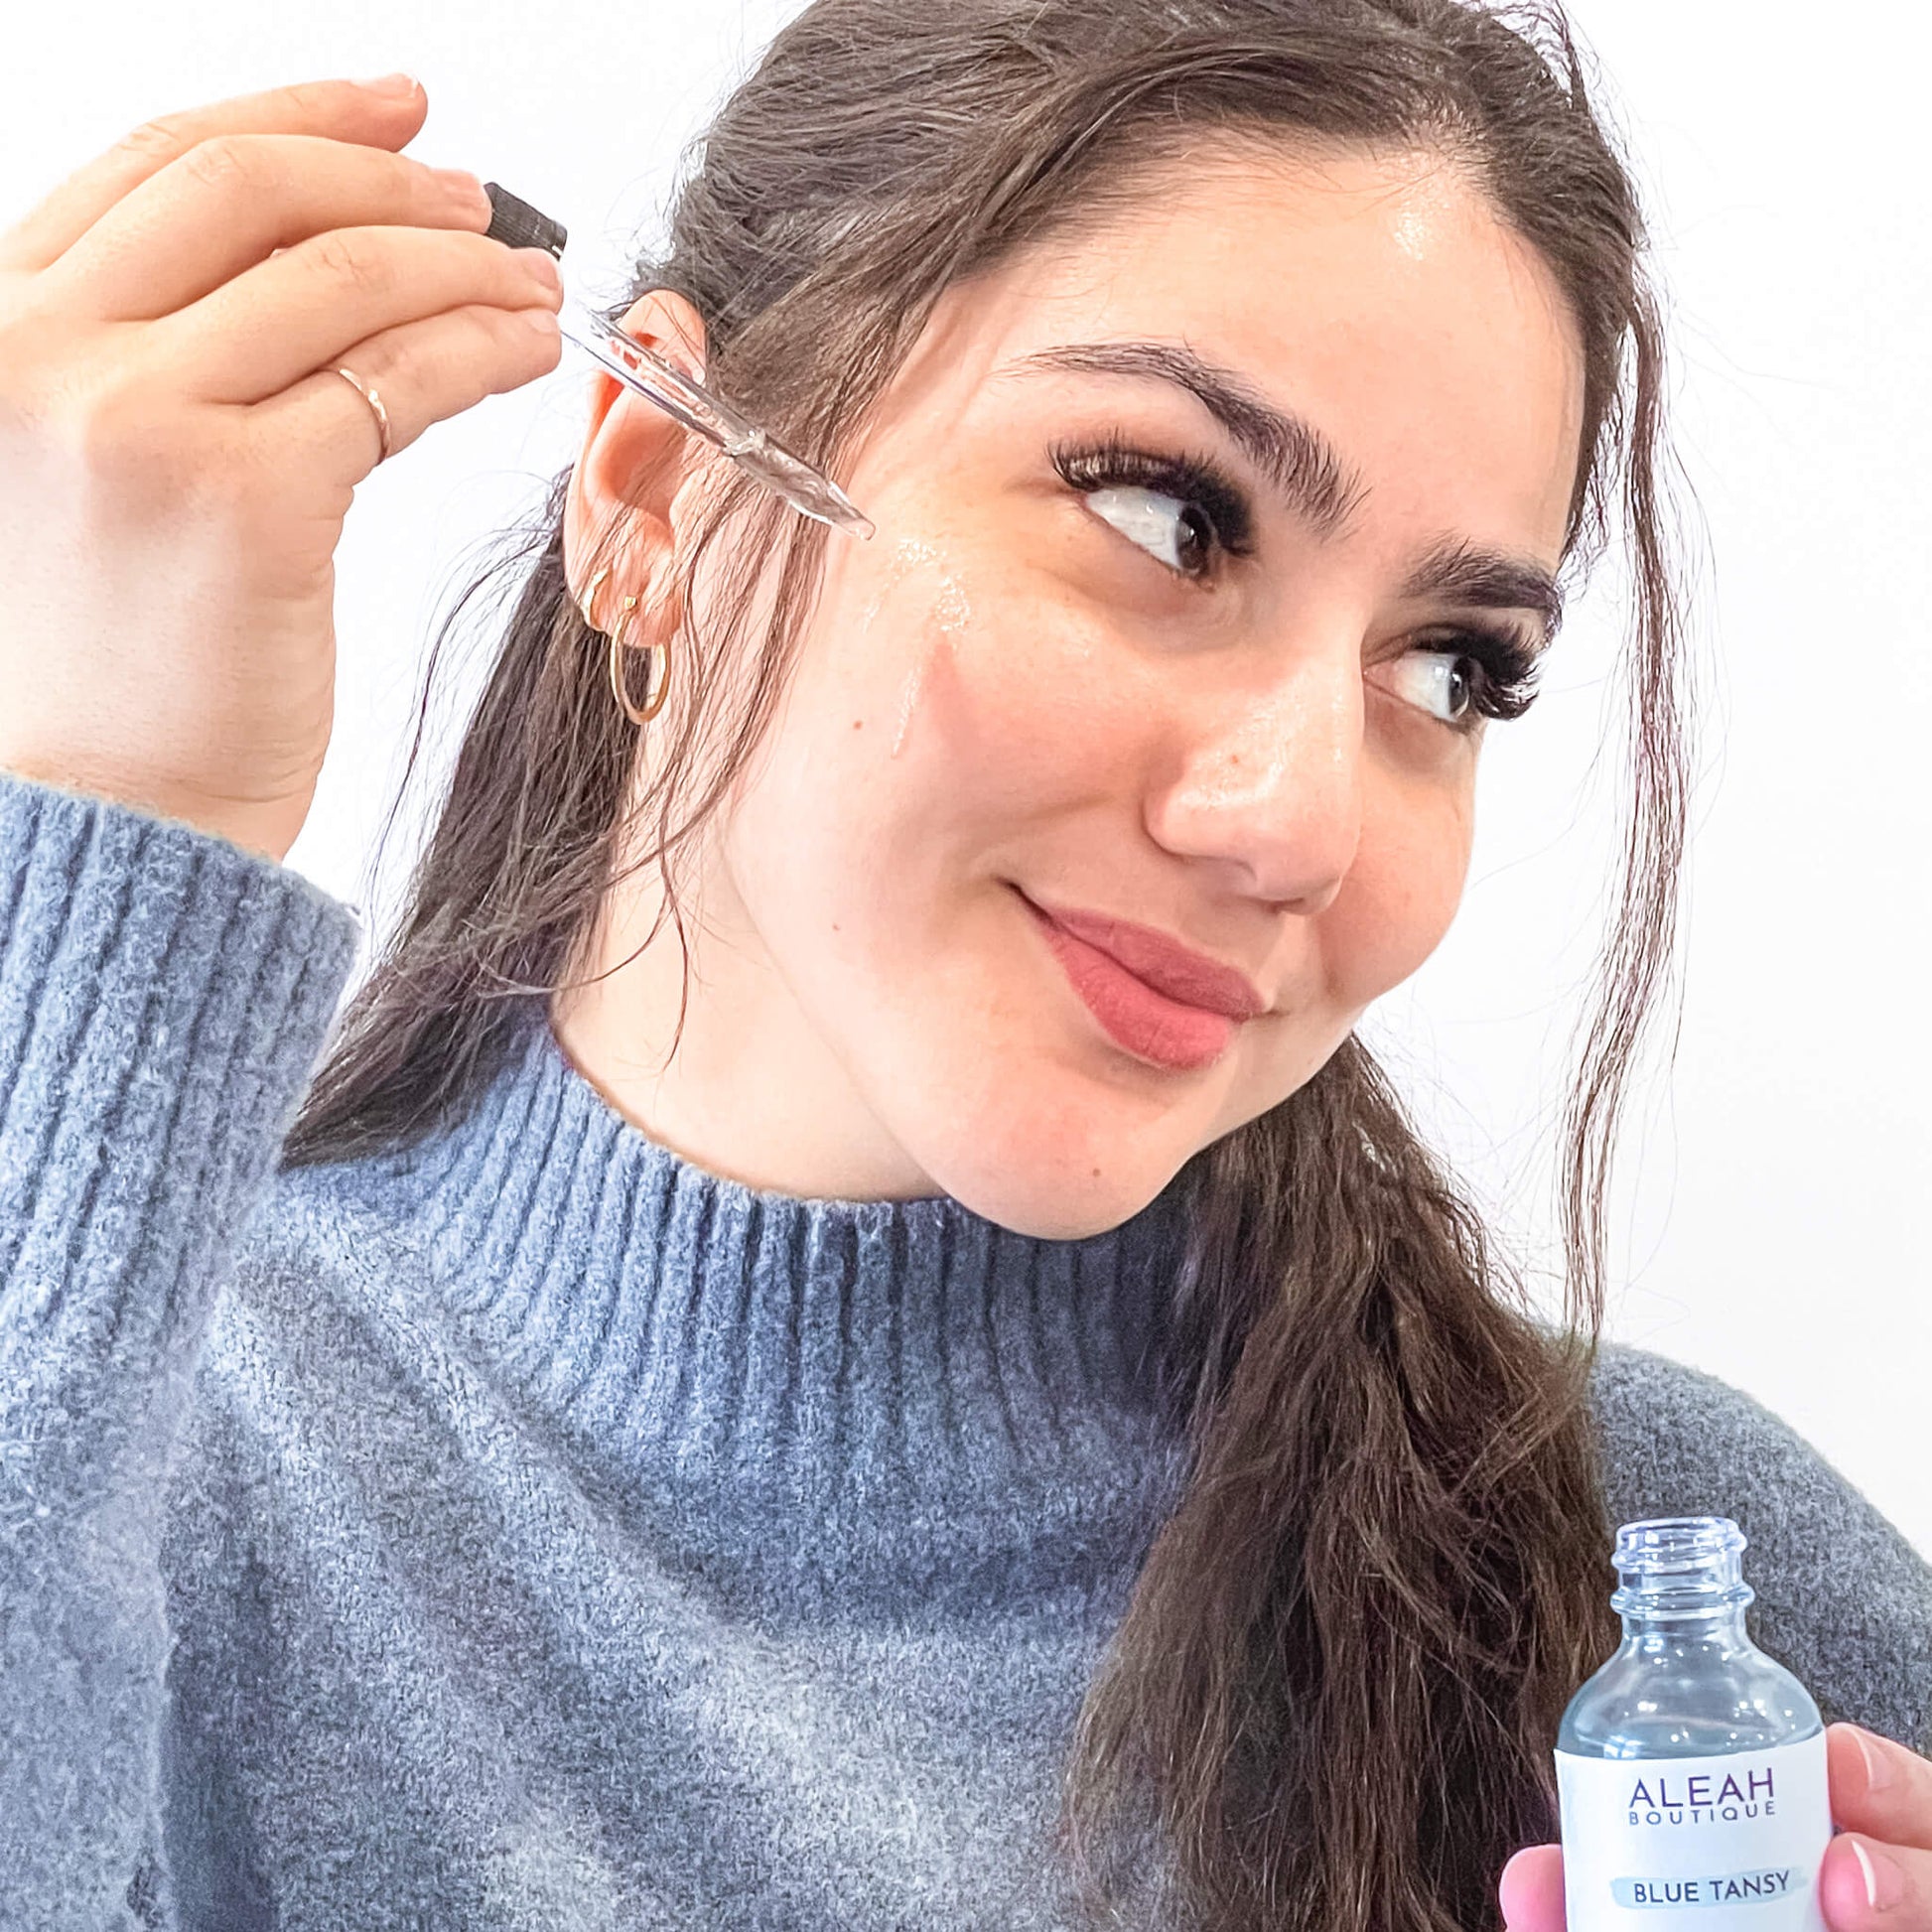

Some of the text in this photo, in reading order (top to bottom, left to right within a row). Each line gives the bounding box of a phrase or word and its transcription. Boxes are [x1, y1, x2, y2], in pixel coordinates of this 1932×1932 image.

[1628, 1767, 1775, 1809] ALEAH
[1628, 1800, 1777, 1826] BOUTIQUE
[1634, 1869, 1791, 1903] BLUE TANSY
